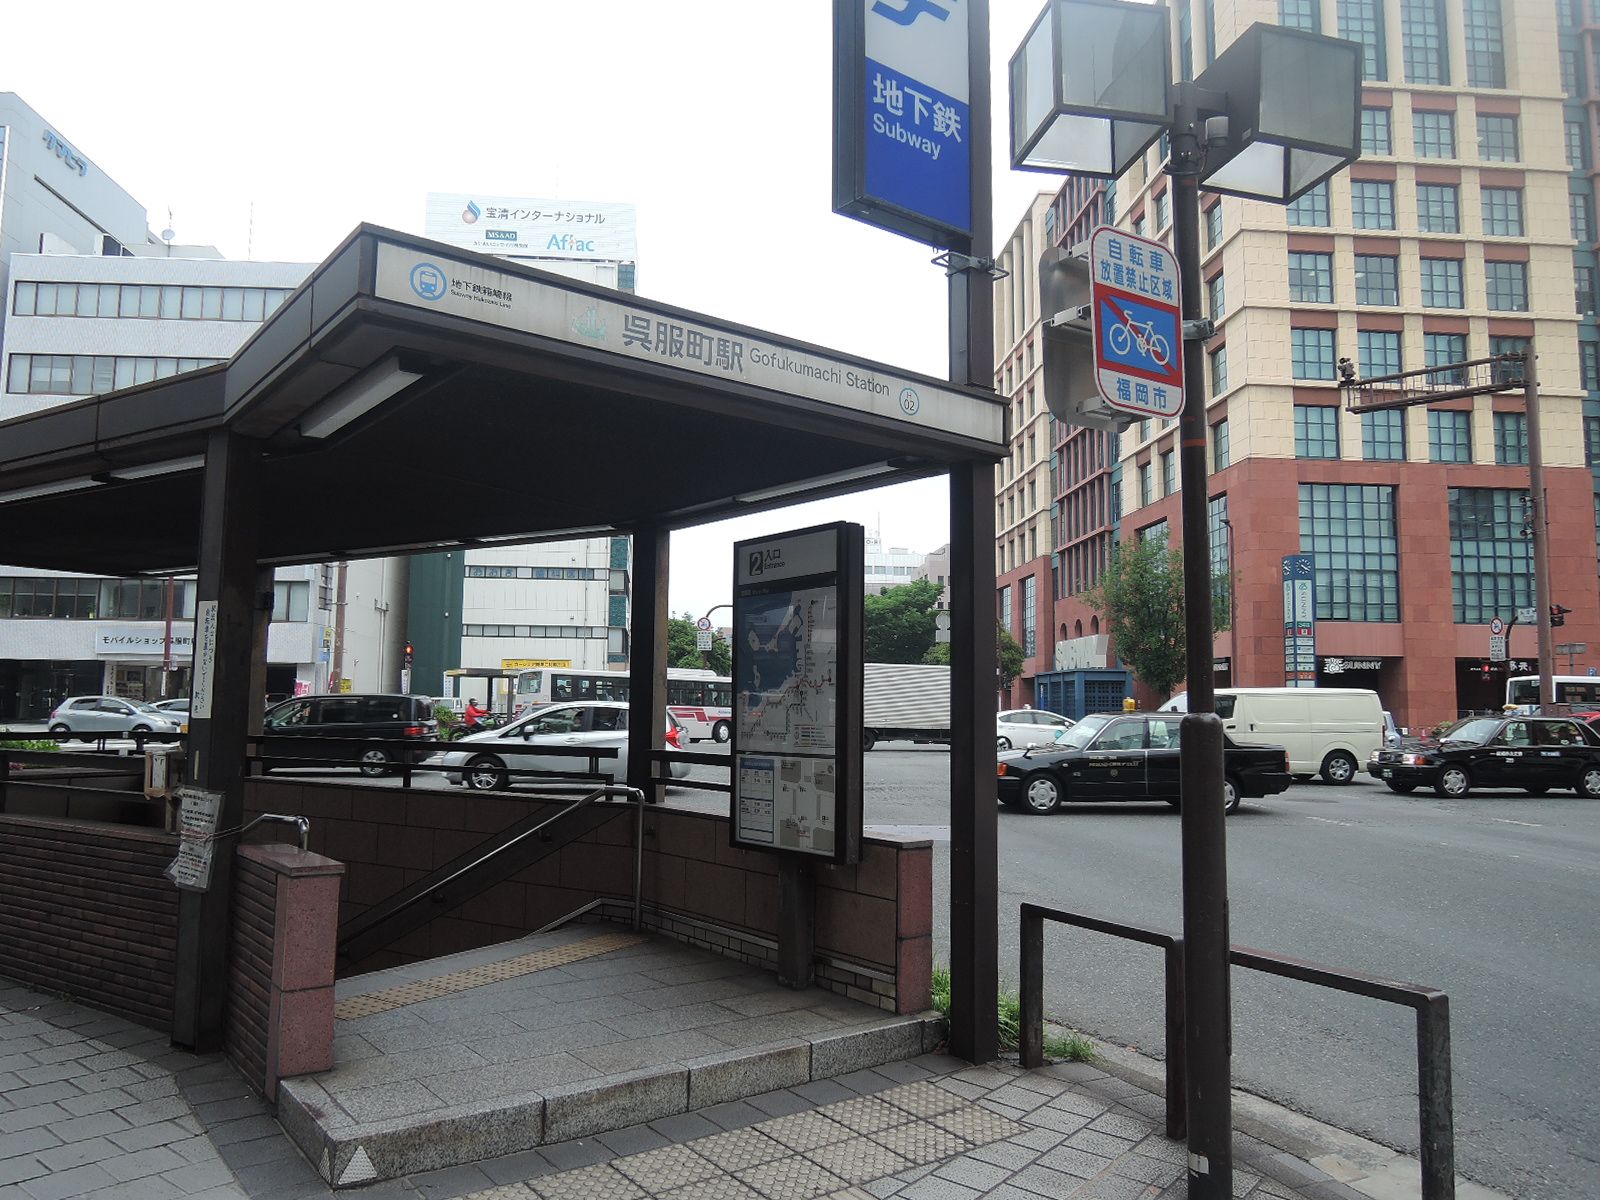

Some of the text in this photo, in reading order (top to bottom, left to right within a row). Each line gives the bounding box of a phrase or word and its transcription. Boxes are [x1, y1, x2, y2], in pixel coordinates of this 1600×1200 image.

[873, 72, 962, 143] 地下鉄
[873, 113, 941, 160] Subway
[486, 207, 606, 225] 宝清インターナショナル
[546, 233, 595, 252] Aflac
[1108, 238, 1164, 273] 自転車
[1100, 259, 1173, 301] 放置禁止区域
[622, 314, 743, 374] 呉服町駅
[749, 347, 890, 397] Gofukumachi Station
[904, 398, 915, 411] 02
[1116, 377, 1167, 409] 福岡市
[750, 552, 762, 576] 2
[764, 549, 780, 562] 入口
[764, 561, 785, 569] Entrance
[1343, 661, 1382, 670] SUNNY
